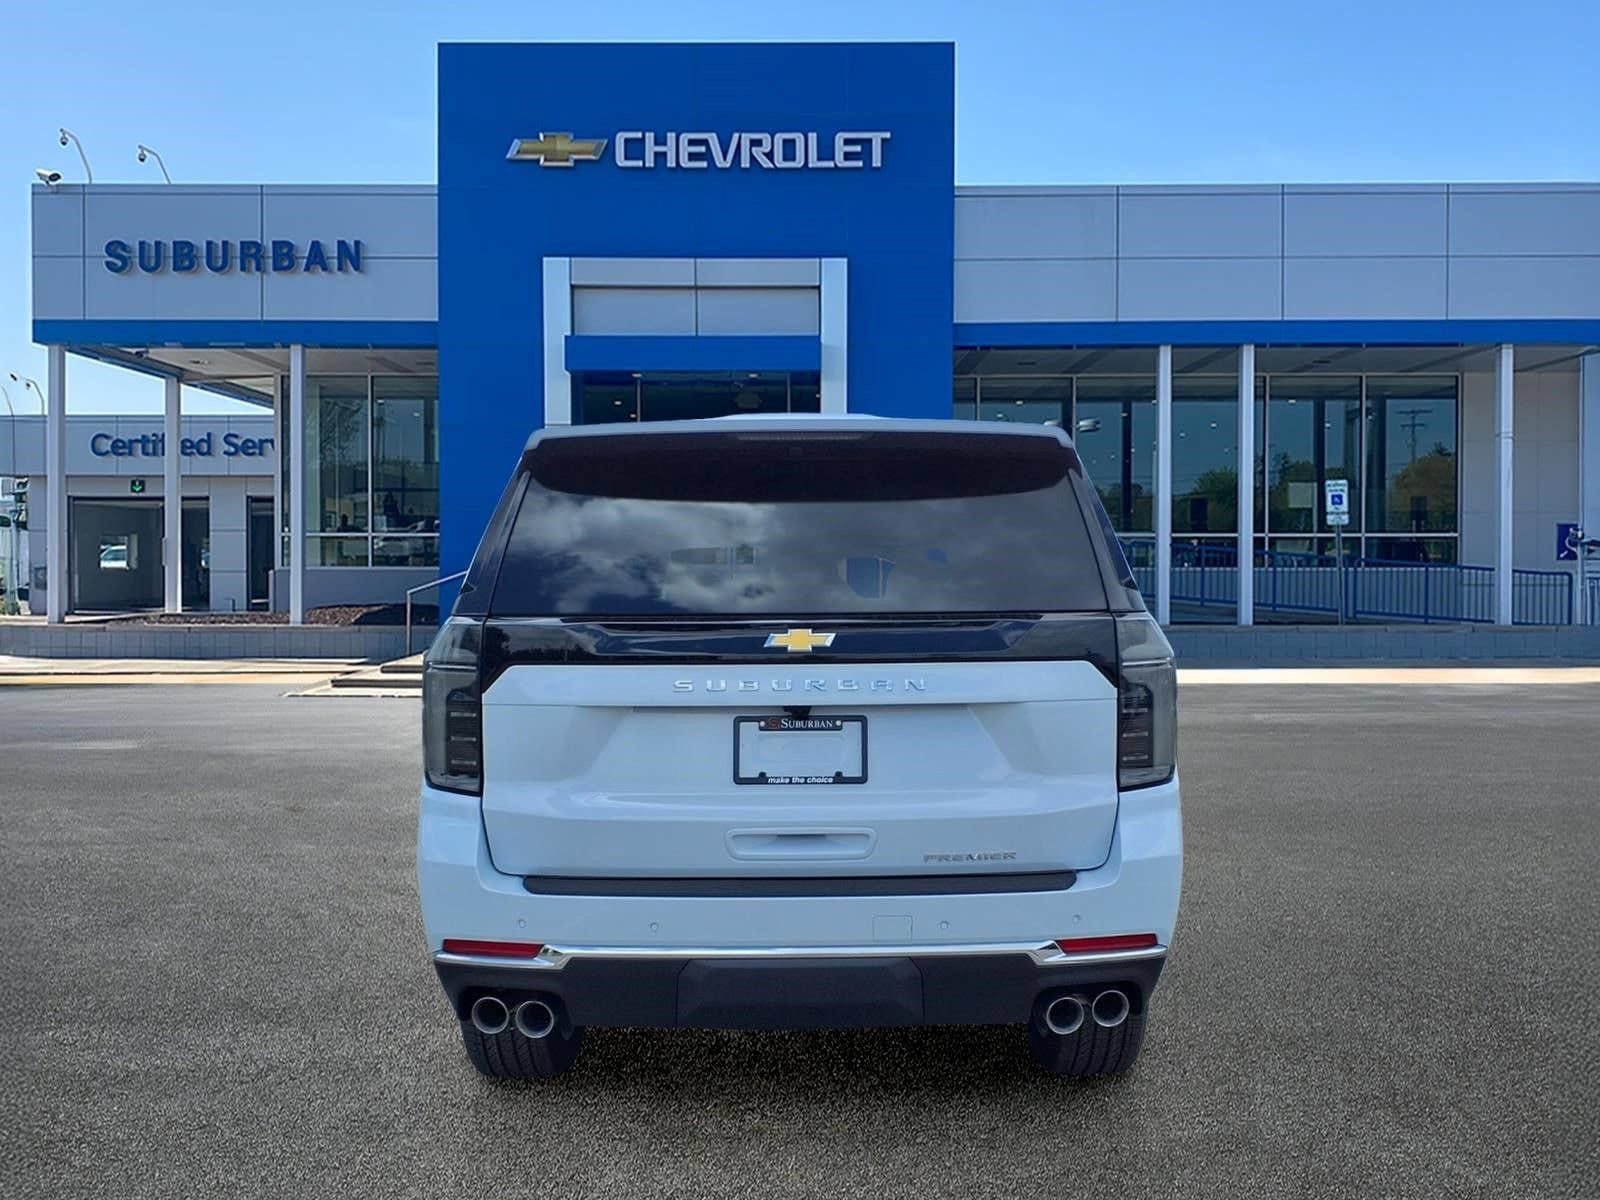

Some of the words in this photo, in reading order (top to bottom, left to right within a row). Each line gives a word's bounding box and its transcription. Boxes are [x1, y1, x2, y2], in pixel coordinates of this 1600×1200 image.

[614, 131, 892, 169] CHEVROLET
[103, 239, 363, 274] SUBURBAN
[90, 431, 213, 457] Certifed
[672, 678, 928, 693] SUBURBAN
[781, 718, 833, 729] SUBURBAN
[768, 776, 790, 784] make
[791, 776, 805, 784] the
[806, 776, 834, 784] choice
[922, 852, 1017, 863] PREMIER
